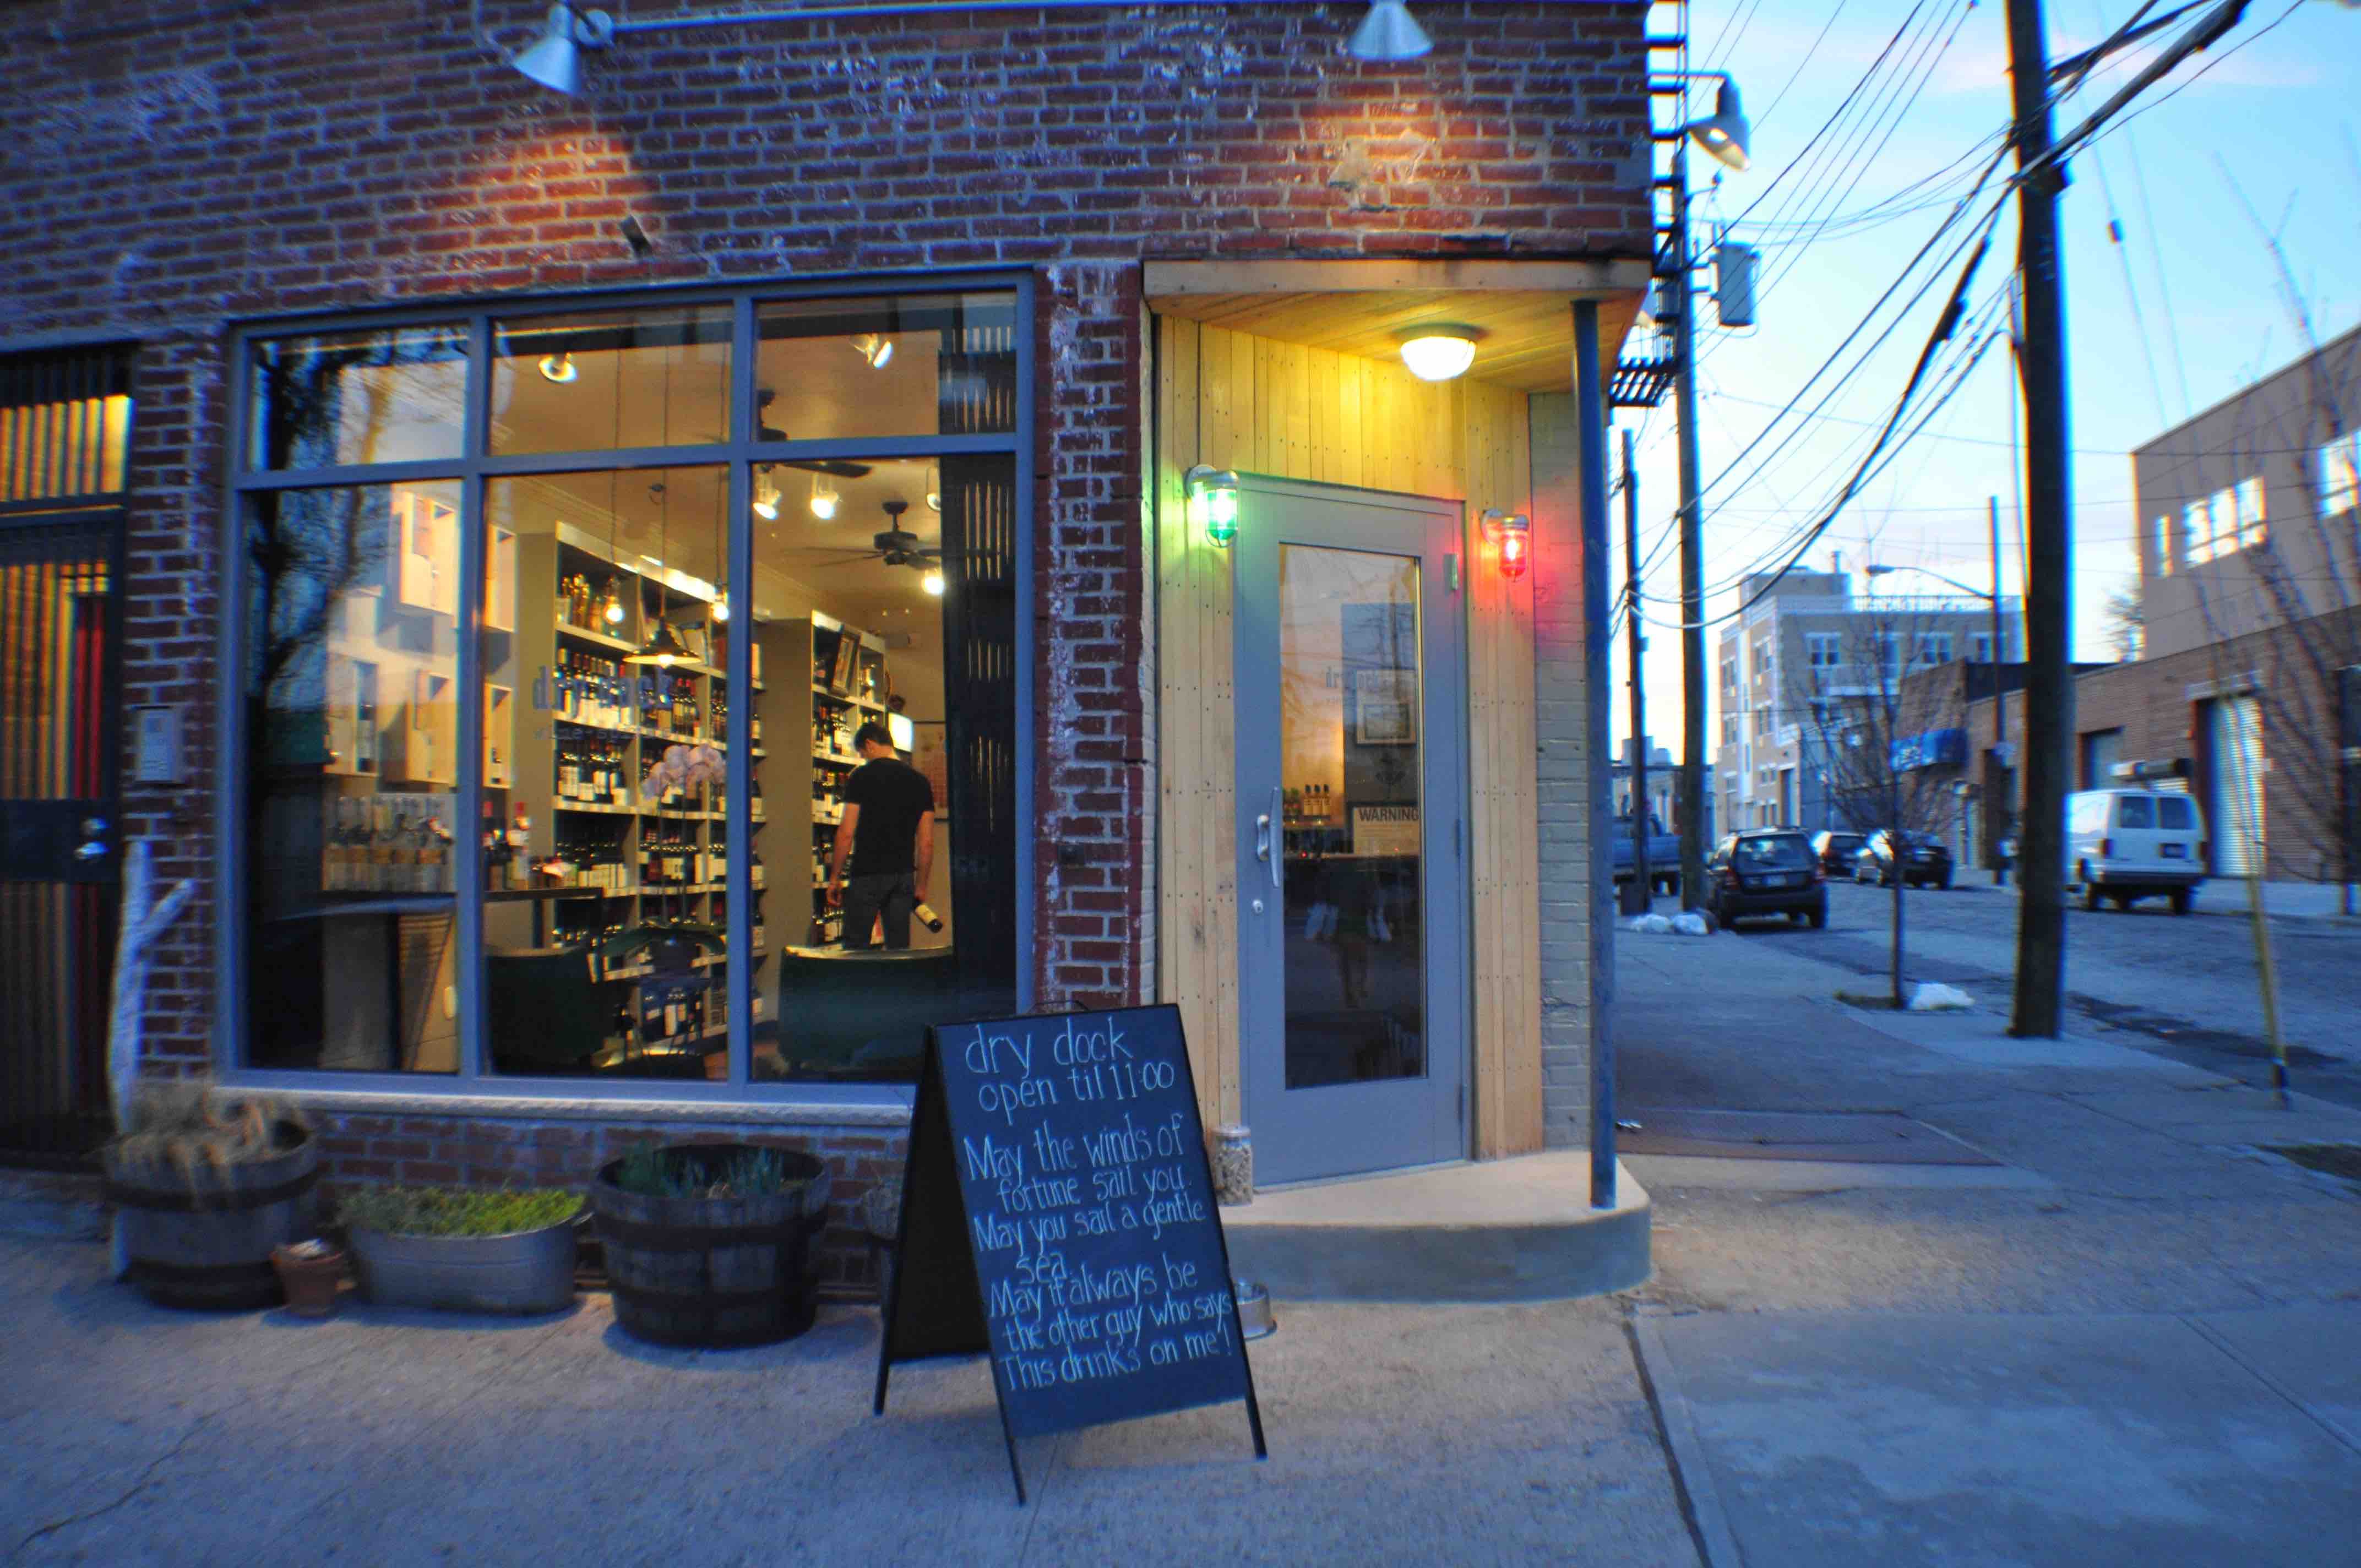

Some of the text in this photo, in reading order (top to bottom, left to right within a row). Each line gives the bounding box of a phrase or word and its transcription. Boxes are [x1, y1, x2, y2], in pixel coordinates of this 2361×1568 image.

[1358, 807, 1419, 821] WARNING
[965, 1016, 1134, 1079] dry dock
[978, 1061, 1174, 1126] open til 11:00
[963, 1112, 1183, 1186] May the winds of
[996, 1177, 1081, 1214] fortune
[1092, 1164, 1138, 1201] sail
[973, 1191, 1206, 1257] May you sail a gentle
[991, 1278, 1042, 1322] May
[1070, 1262, 1157, 1305] always
[1163, 1251, 1199, 1291] be
[1003, 1291, 1233, 1352] the other guy who says
[999, 1354, 1056, 1391] This
[1150, 1338, 1180, 1365] on
[1184, 1321, 1232, 1360] me!
